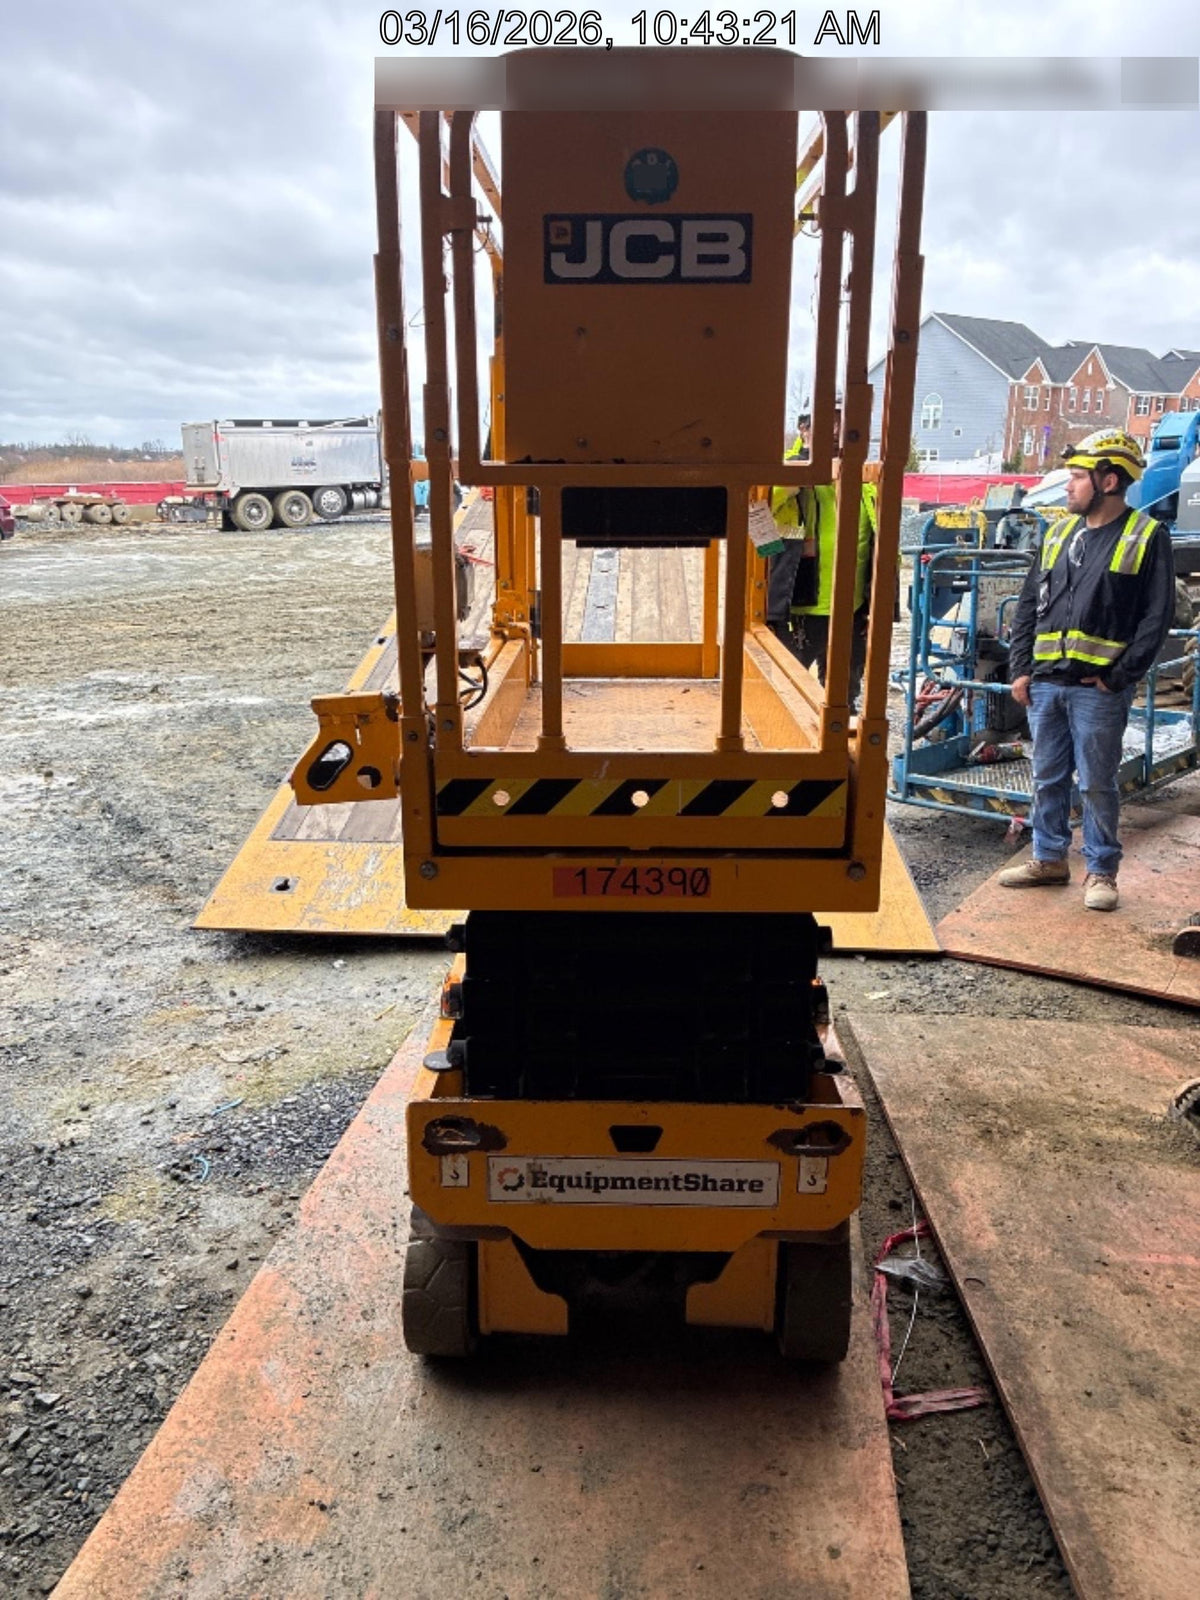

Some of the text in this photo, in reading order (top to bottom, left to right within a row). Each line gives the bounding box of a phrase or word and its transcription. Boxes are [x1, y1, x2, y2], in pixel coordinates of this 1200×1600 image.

[549, 219, 747, 279] JCB
[574, 867, 710, 897] 174390
[530, 1170, 764, 1194] EquipmentShare
